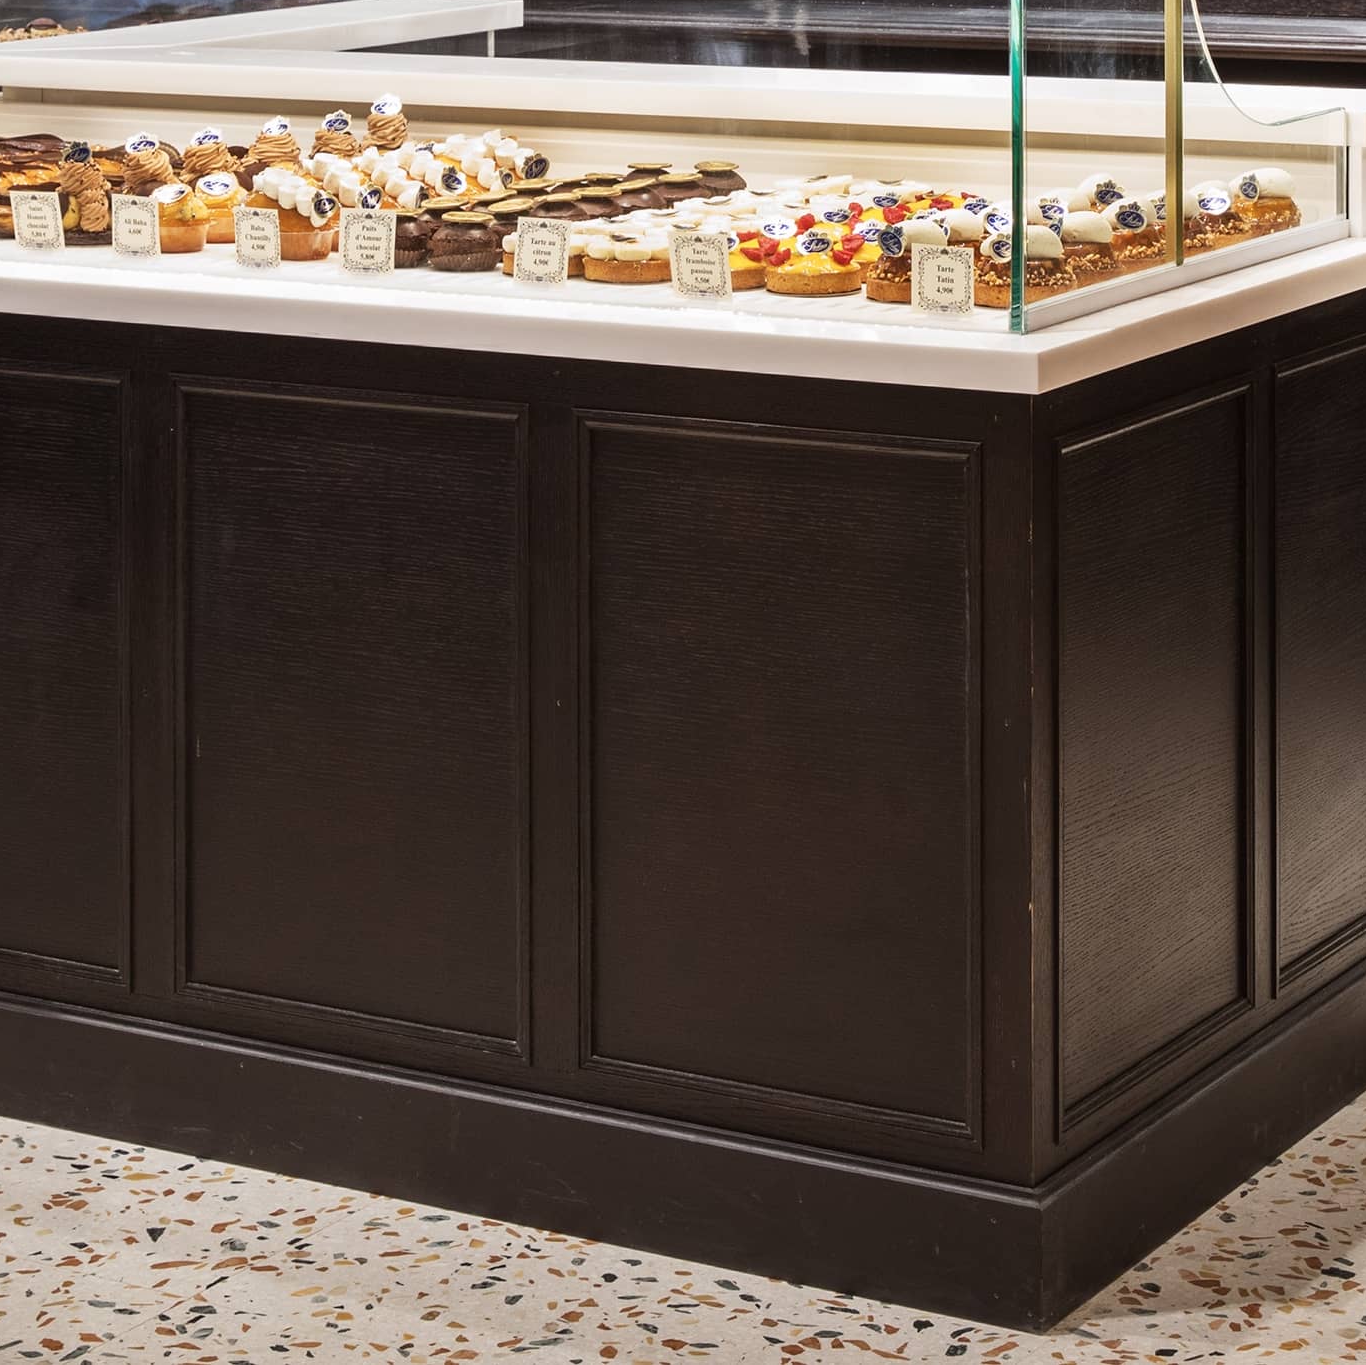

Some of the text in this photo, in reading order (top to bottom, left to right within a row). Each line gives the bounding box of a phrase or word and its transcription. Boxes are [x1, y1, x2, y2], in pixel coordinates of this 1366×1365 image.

[245, 234, 271, 243] Chantilly
[530, 237, 547, 246] Tarte
[692, 247, 708, 255] Tarte
[685, 257, 716, 266] framboise
[690, 268, 713, 276] passion
[937, 265, 955, 273] Tarte
[937, 275, 955, 284] Tatin
